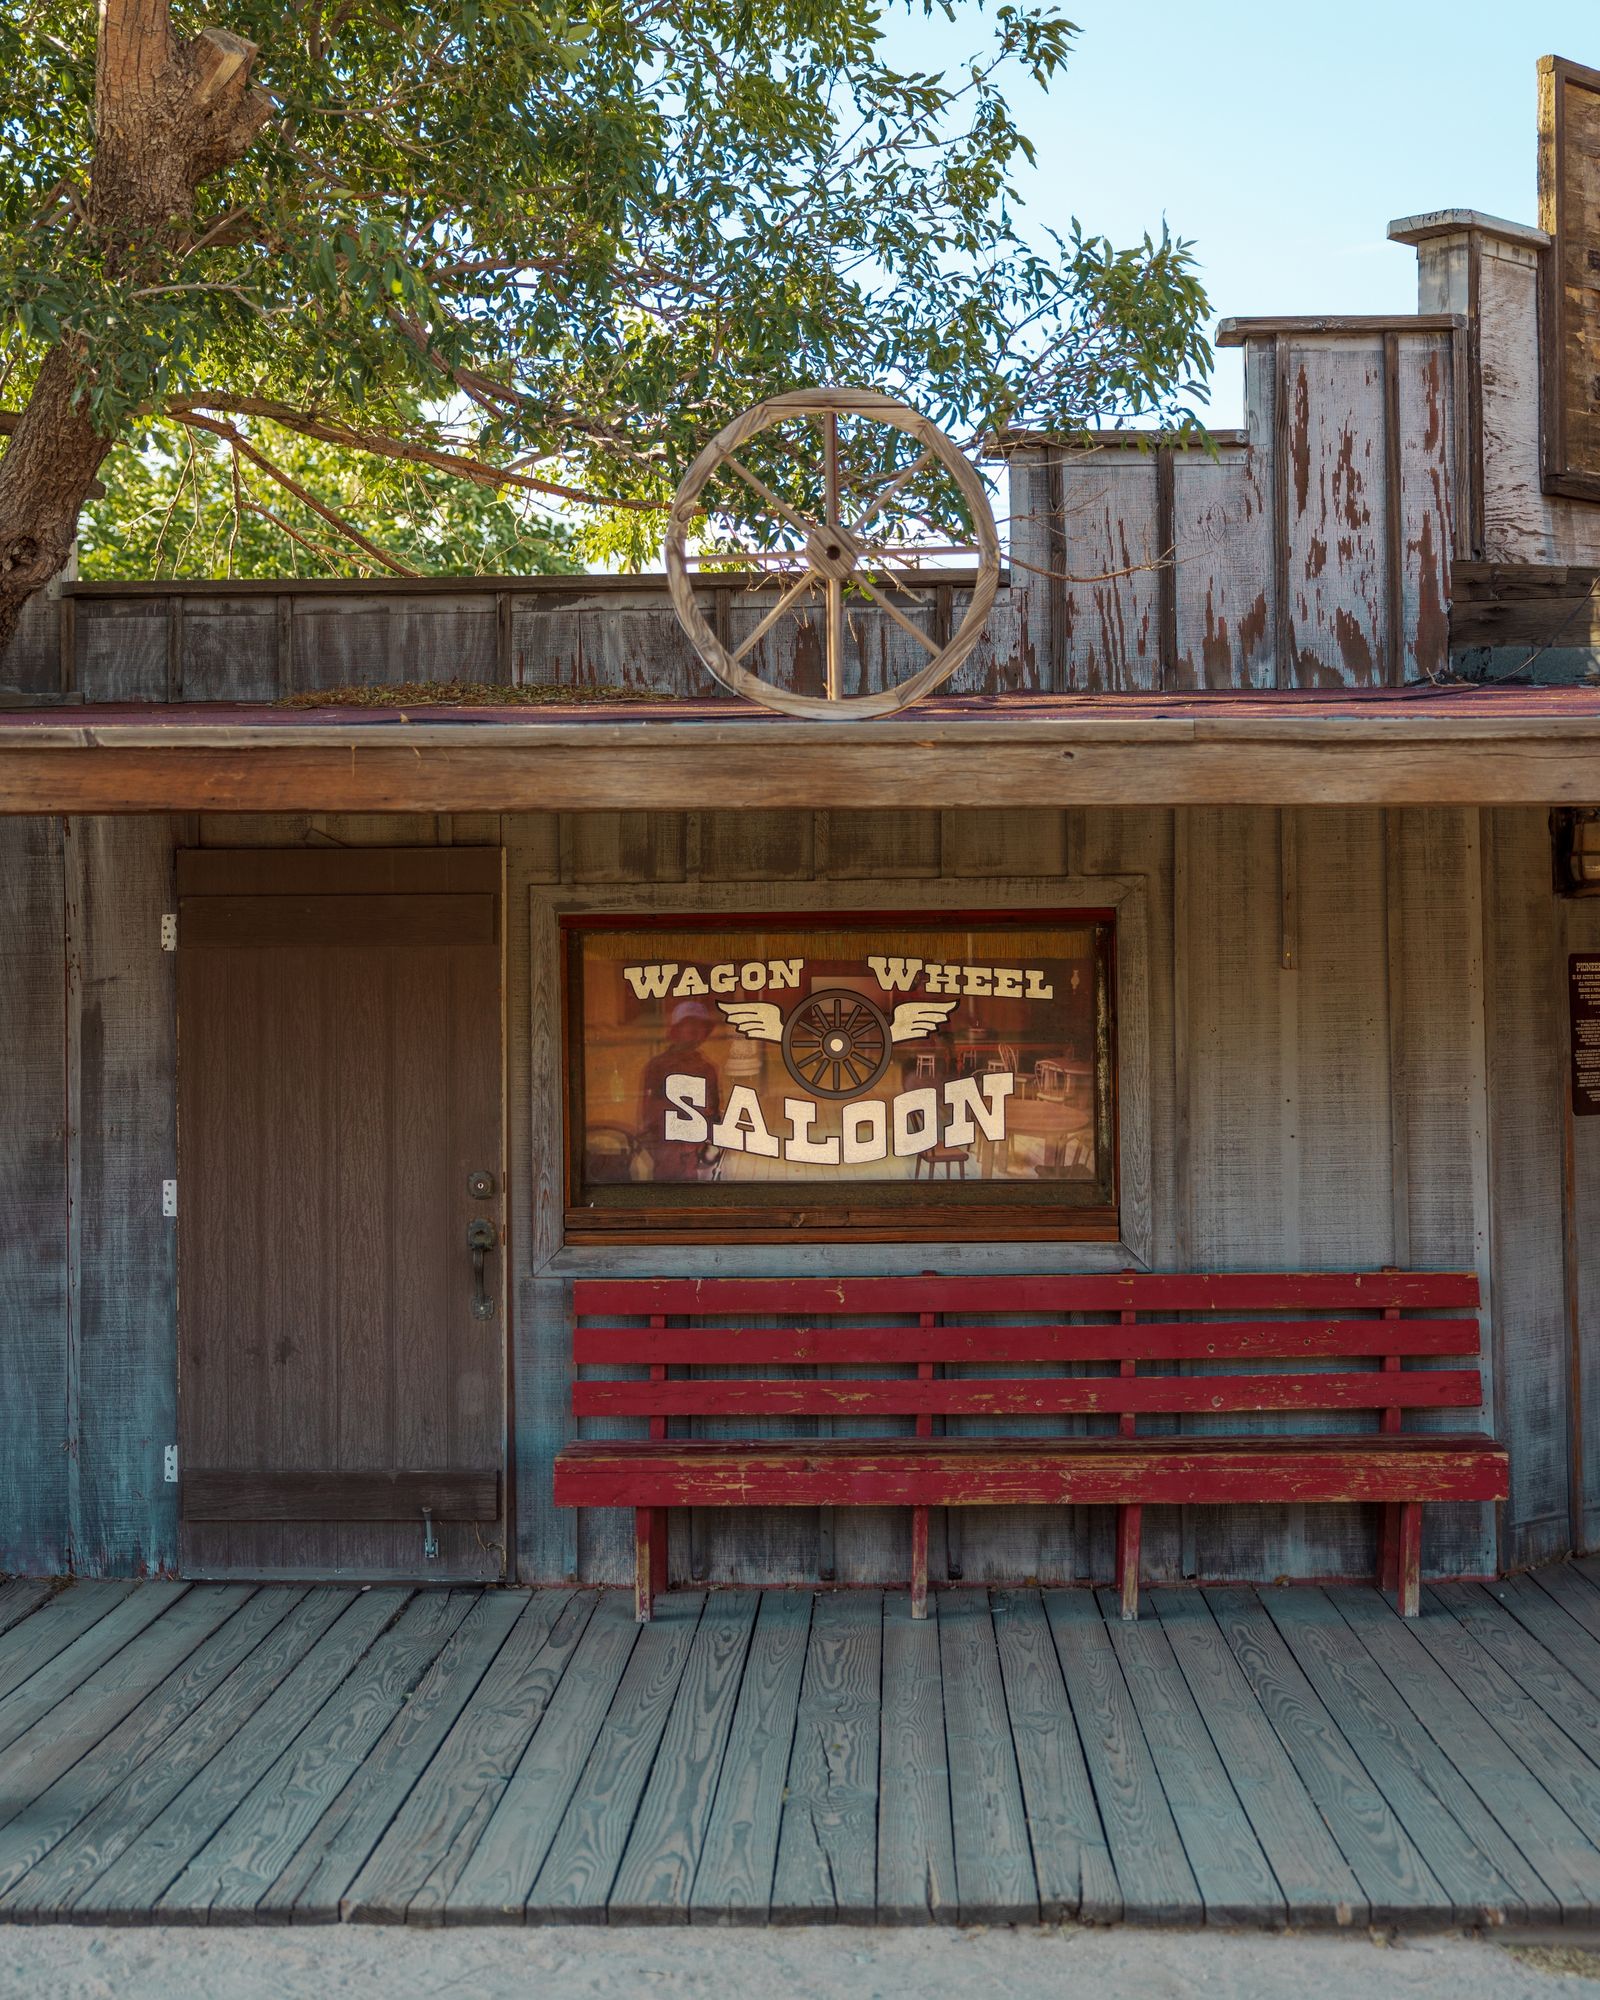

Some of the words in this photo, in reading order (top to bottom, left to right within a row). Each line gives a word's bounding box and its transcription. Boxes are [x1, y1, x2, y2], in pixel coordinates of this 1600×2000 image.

[623, 957, 805, 1000] WAGON
[866, 955, 1054, 1000] WHEEL
[664, 1072, 1015, 1166] SALOON
